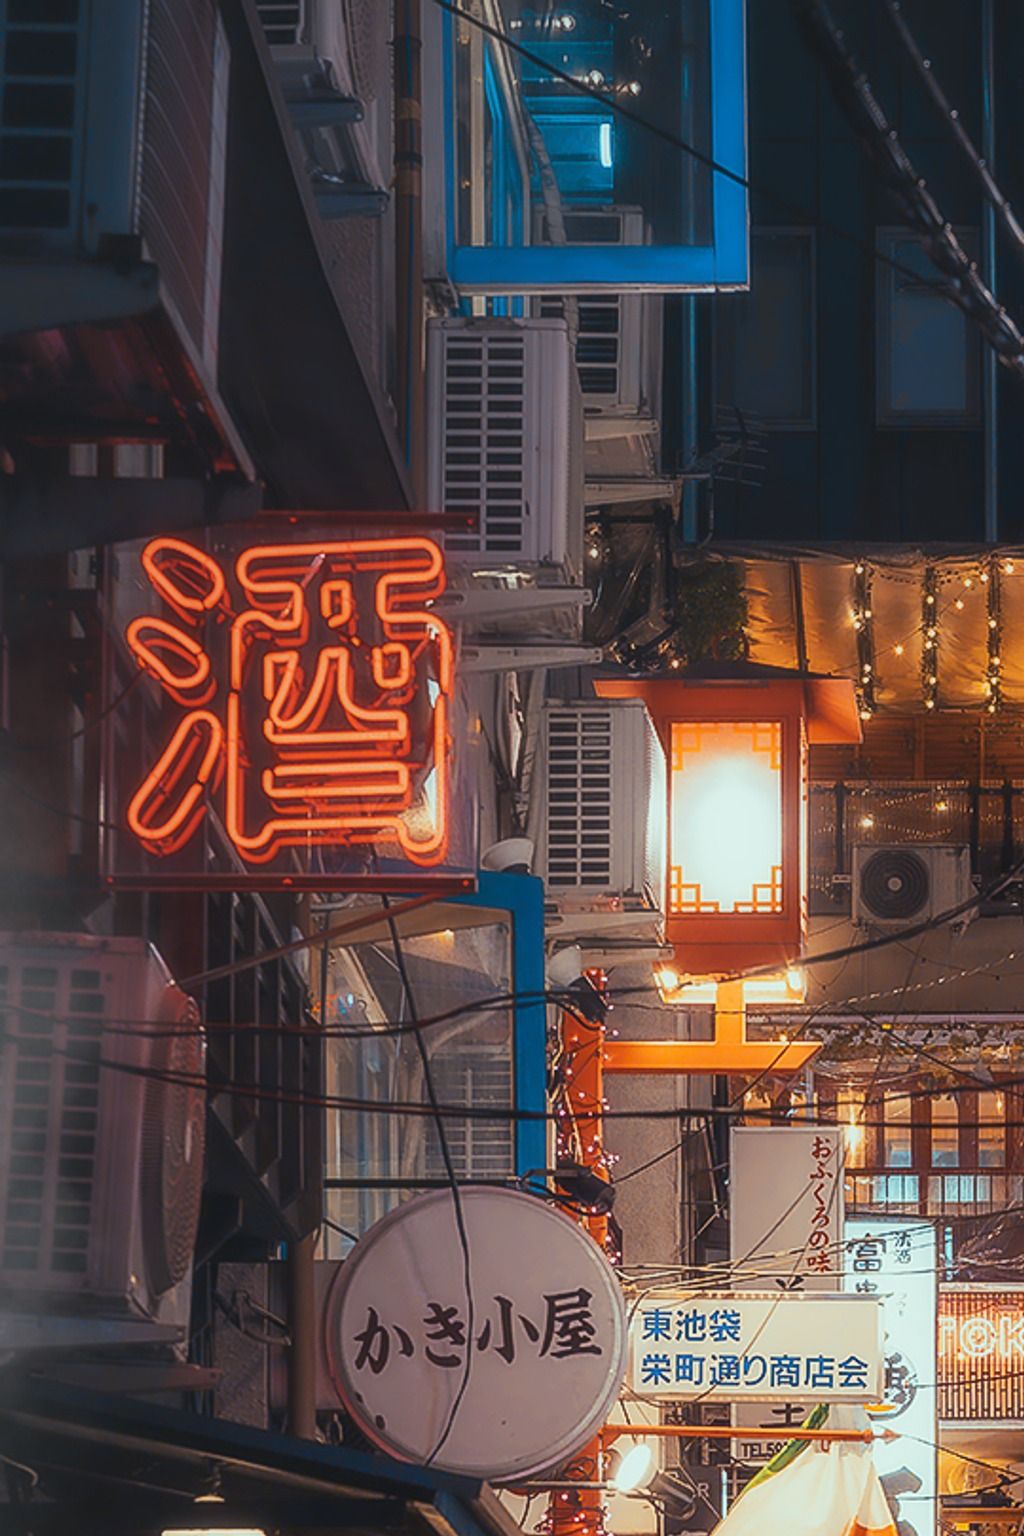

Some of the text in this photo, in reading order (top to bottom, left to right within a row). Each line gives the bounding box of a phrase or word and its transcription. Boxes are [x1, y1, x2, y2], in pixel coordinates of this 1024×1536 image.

[127, 536, 452, 864] 酒
[806, 1136, 833, 1272] おふくろの味
[354, 1288, 603, 1372] かき小屋
[641, 1308, 741, 1342] 東池袋
[641, 1354, 868, 1389] 栄町通り商店会
